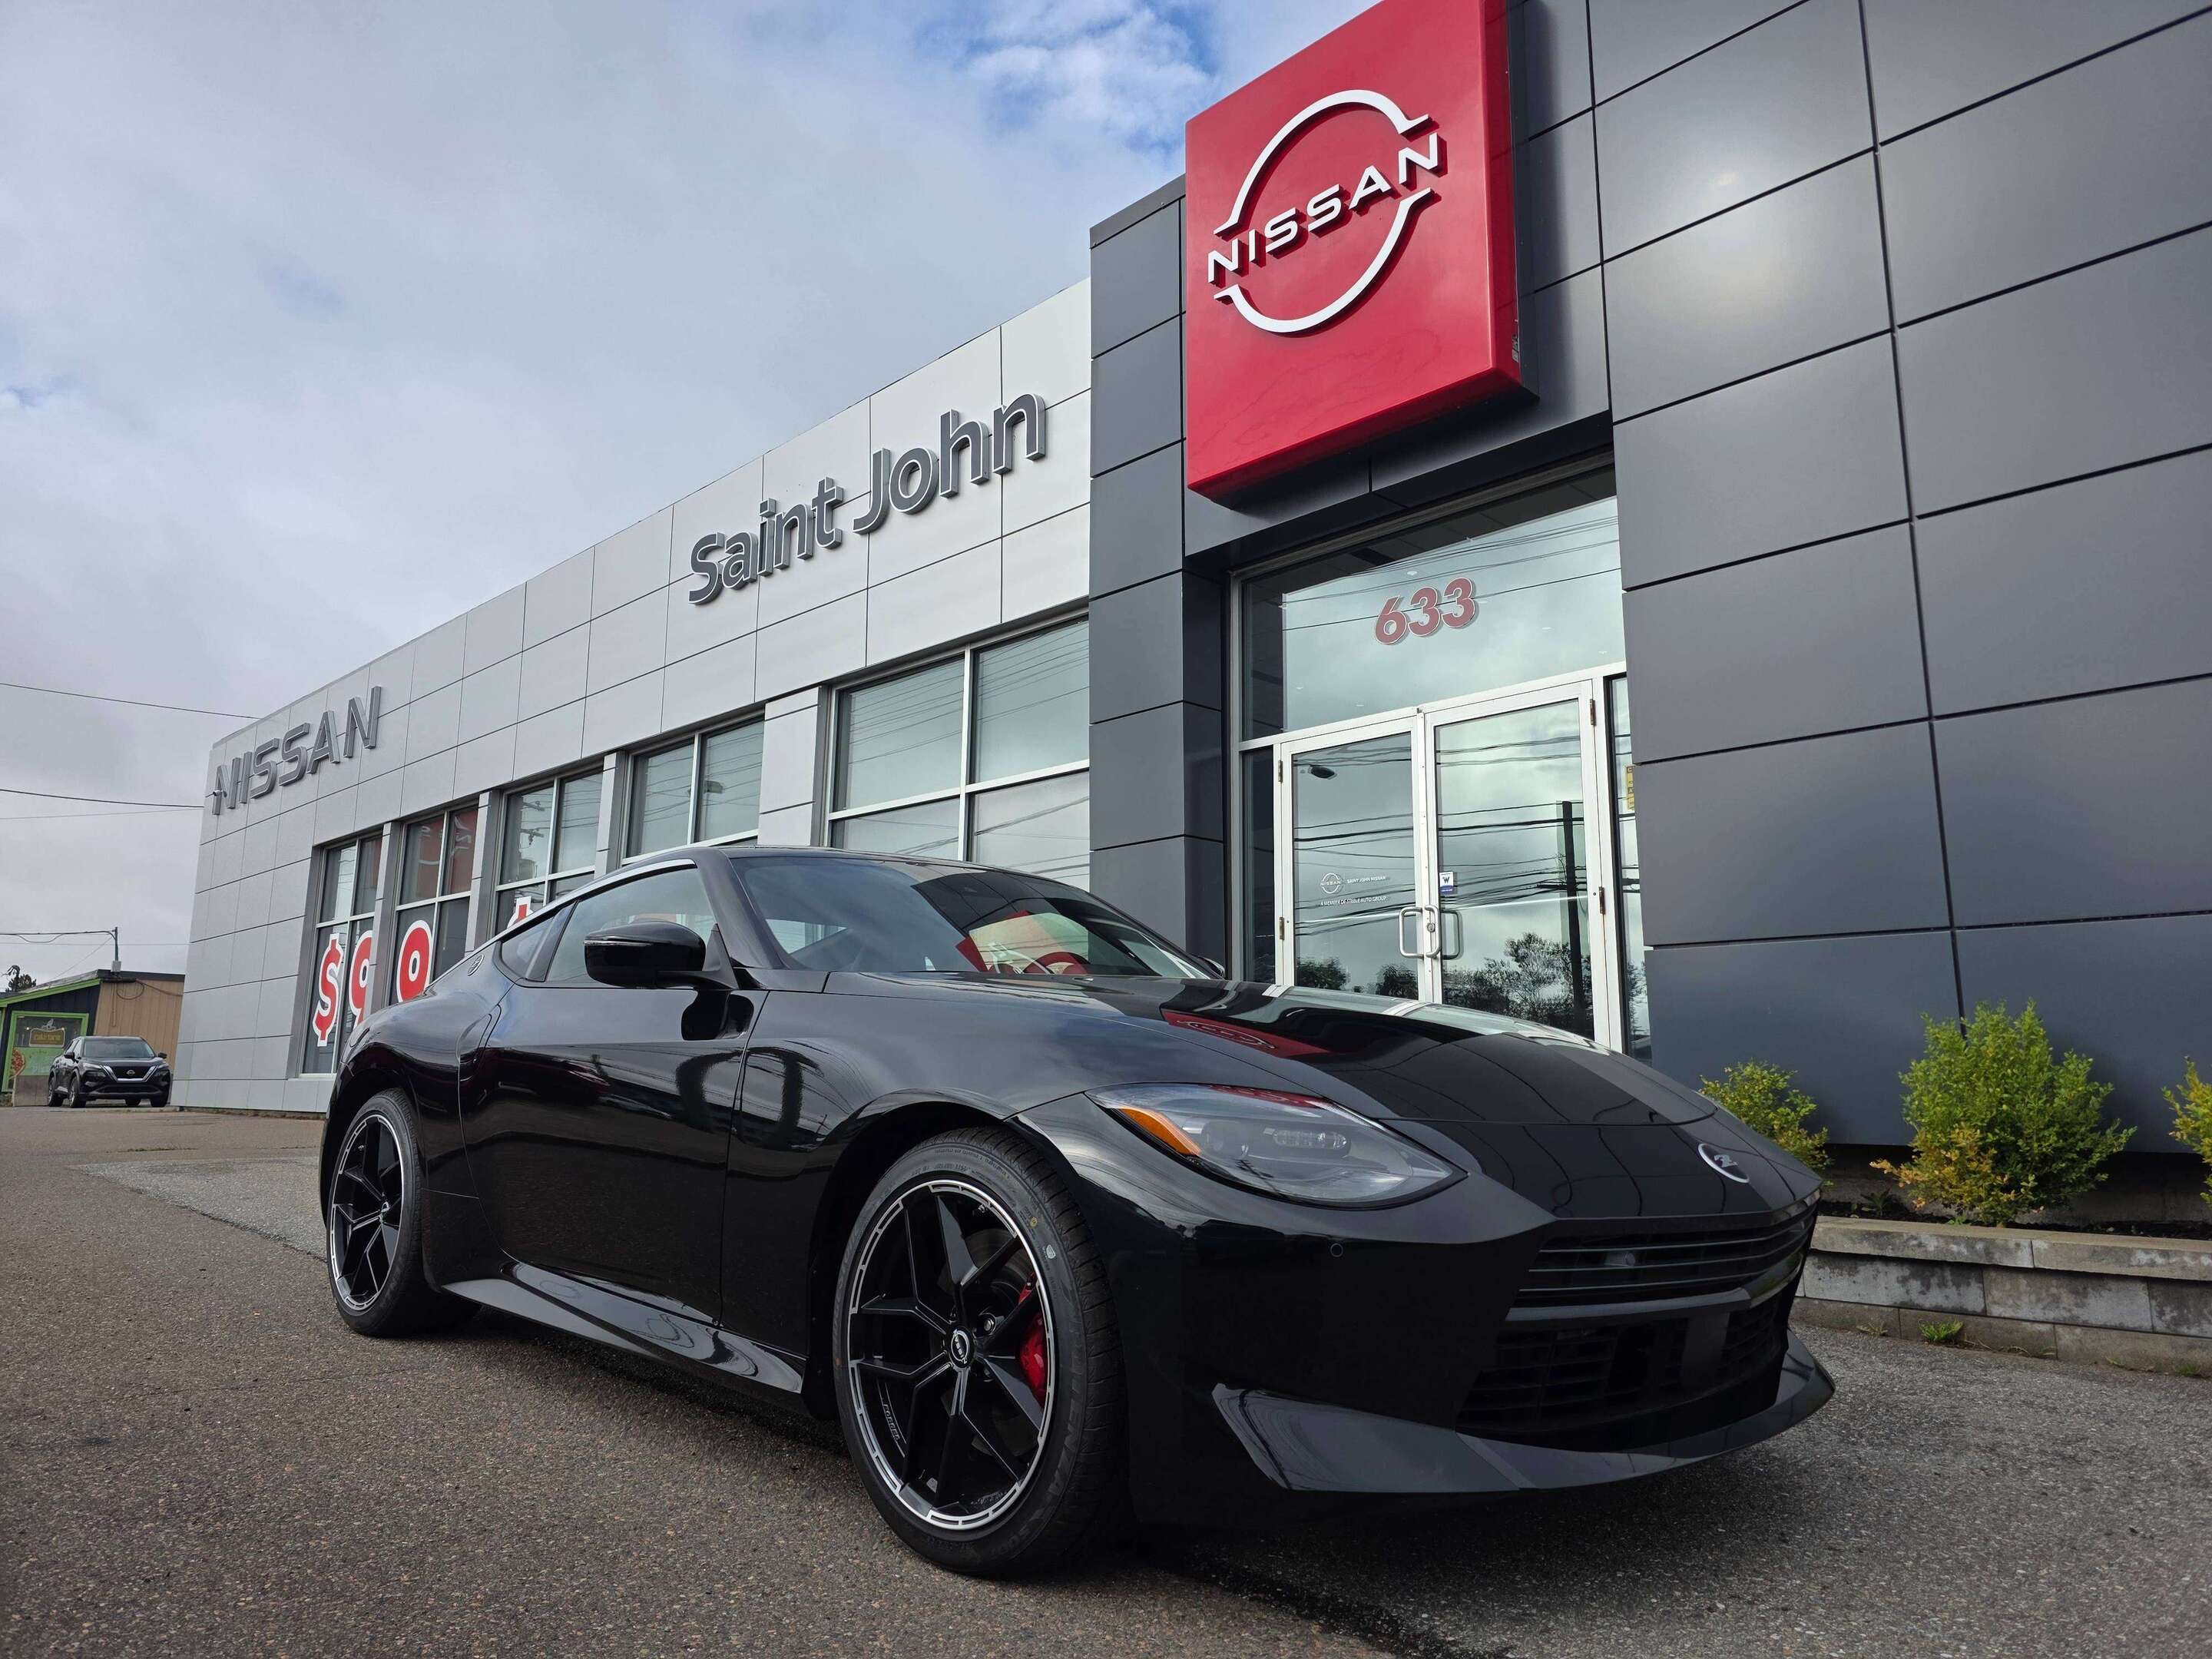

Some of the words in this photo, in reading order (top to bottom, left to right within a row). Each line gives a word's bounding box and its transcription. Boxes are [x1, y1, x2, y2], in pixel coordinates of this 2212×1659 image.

[1207, 132, 1441, 286] NISSAN
[688, 477, 844, 604] Saint
[853, 392, 1046, 535] John
[1376, 578, 1476, 645] 633
[212, 686, 382, 815] NISSAN
